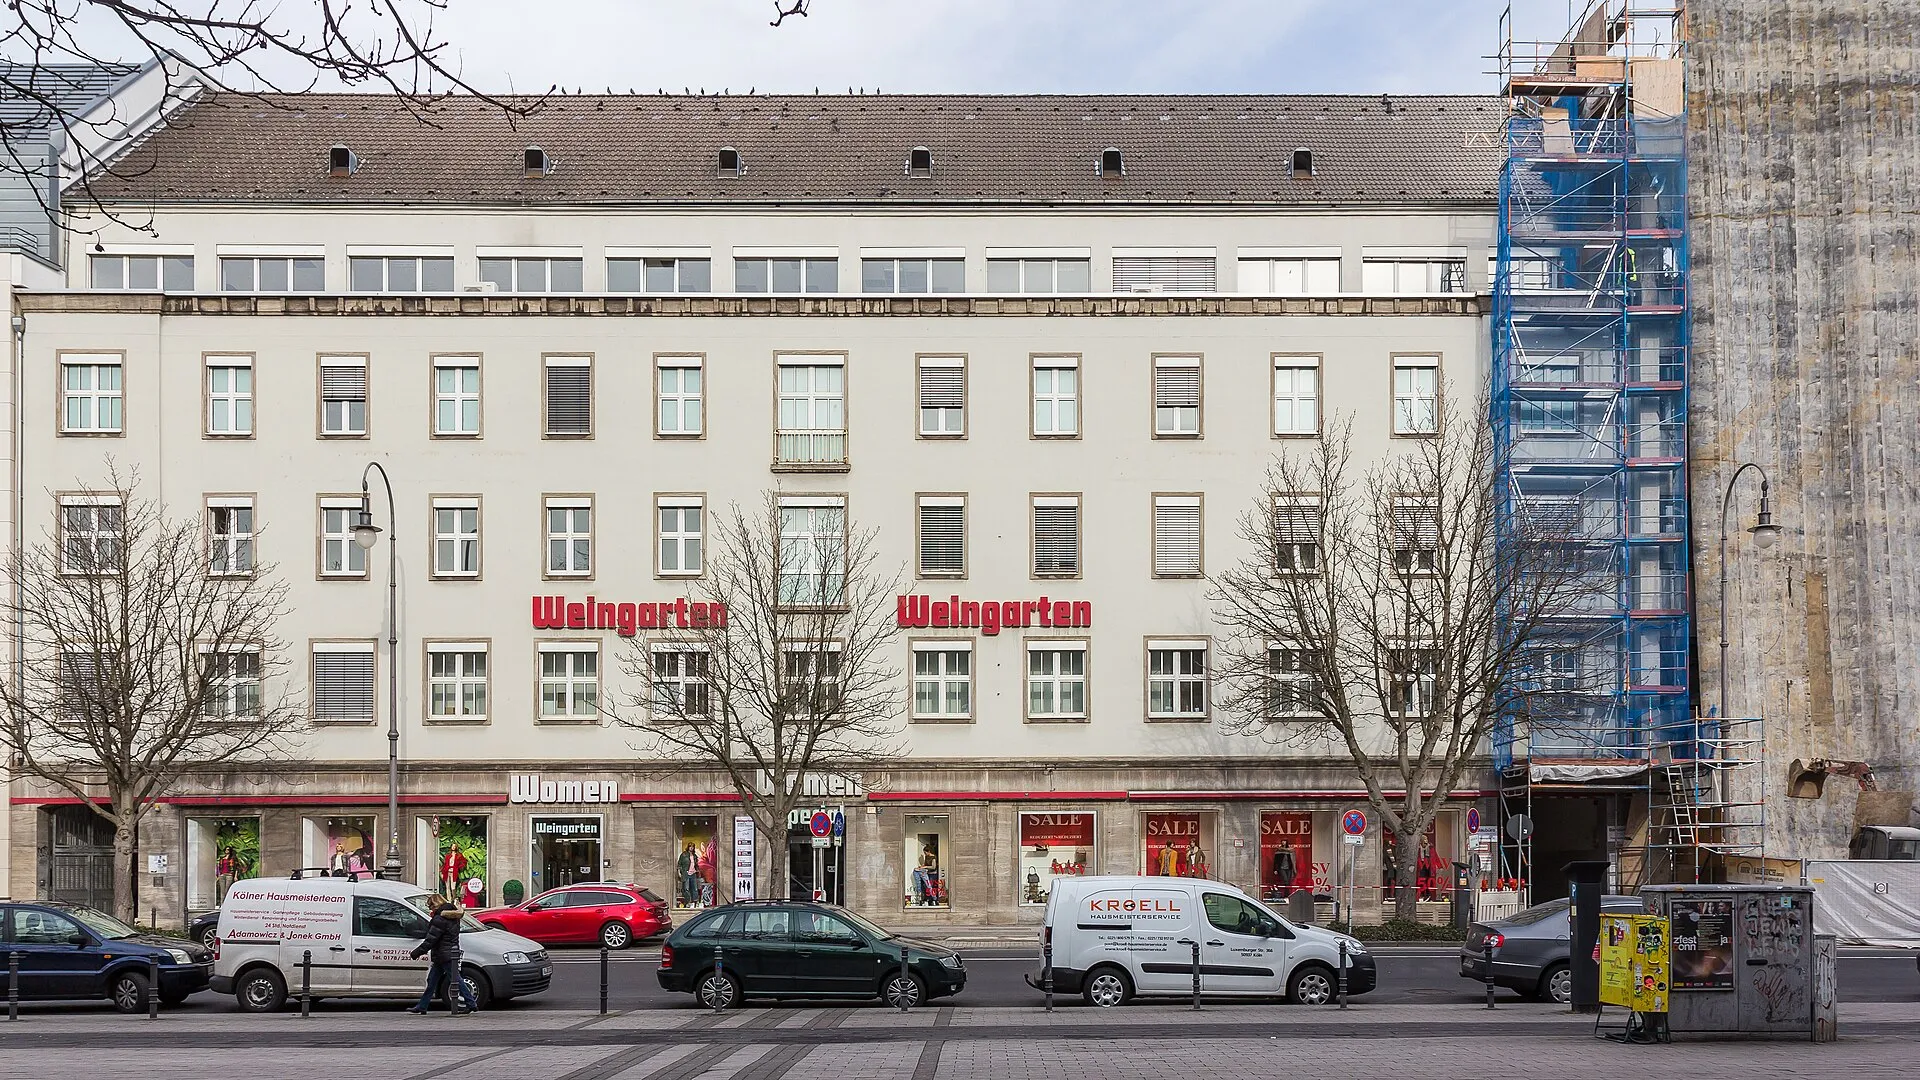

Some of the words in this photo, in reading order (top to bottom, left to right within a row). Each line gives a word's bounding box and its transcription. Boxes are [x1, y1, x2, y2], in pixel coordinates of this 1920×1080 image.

[532, 596, 728, 637] Weingarten
[898, 595, 1092, 636] Weingarten
[510, 775, 618, 804] Women
[1029, 814, 1082, 826] SALE
[535, 823, 597, 835] Weingarten
[1148, 820, 1198, 836] SALE
[1261, 820, 1311, 835] SALE
[1051, 863, 1088, 875] WSV
[232, 891, 265, 901] Kölner
[266, 892, 346, 903] Hausmeisterteam
[1090, 899, 1182, 912] KROELL
[227, 929, 278, 939] Adamowicz
[280, 931, 286, 939] &
[286, 930, 313, 941] Jonek
[314, 933, 342, 941] GmbH
[1673, 934, 1697, 944] zfest
